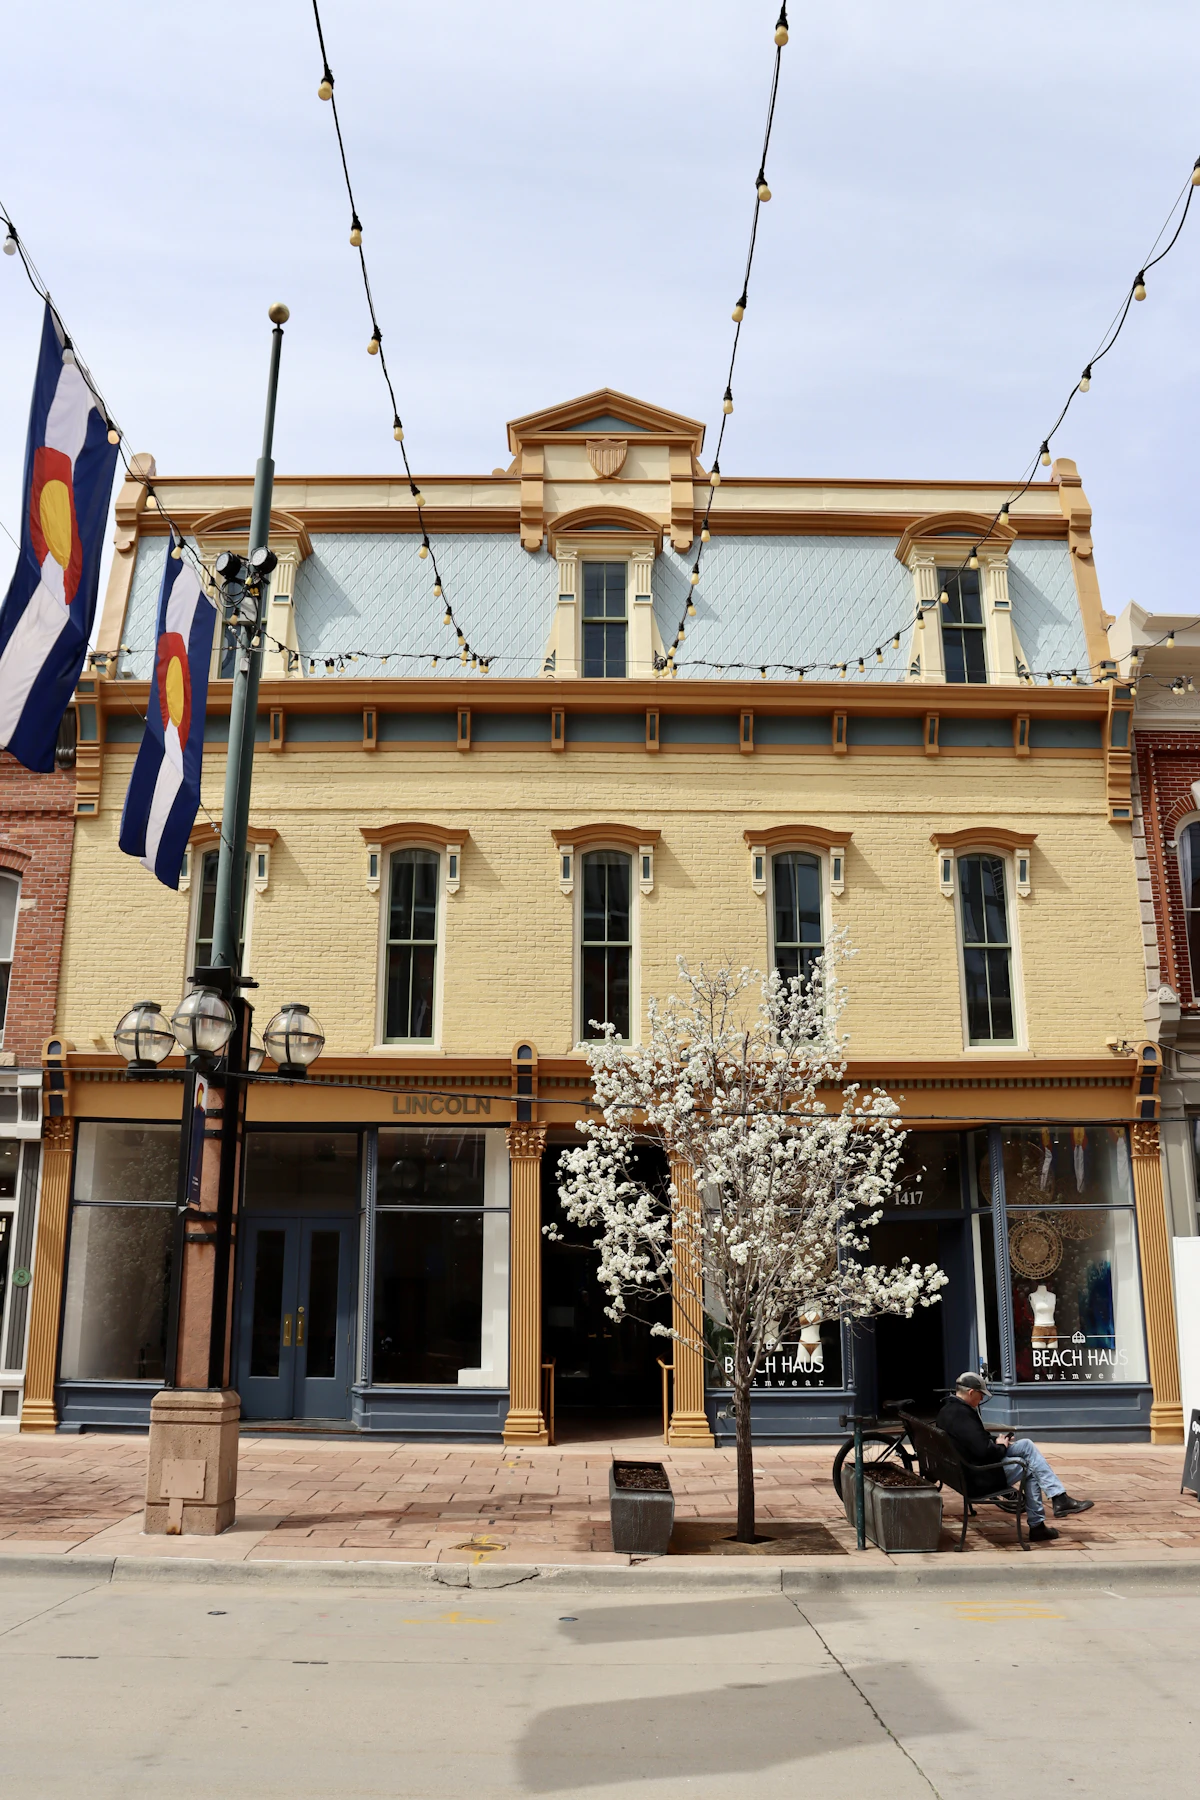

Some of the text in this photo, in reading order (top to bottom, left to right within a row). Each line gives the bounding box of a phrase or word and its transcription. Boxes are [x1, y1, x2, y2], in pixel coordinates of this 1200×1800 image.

[392, 1095, 491, 1115] LINCOLN
[894, 1190, 924, 1206] 1417
[781, 1355, 825, 1374] HAUS
[1032, 1348, 1129, 1367] BEACH HAUS
[725, 1378, 825, 1388] simwear
[1034, 1370, 1129, 1381] swimwear
